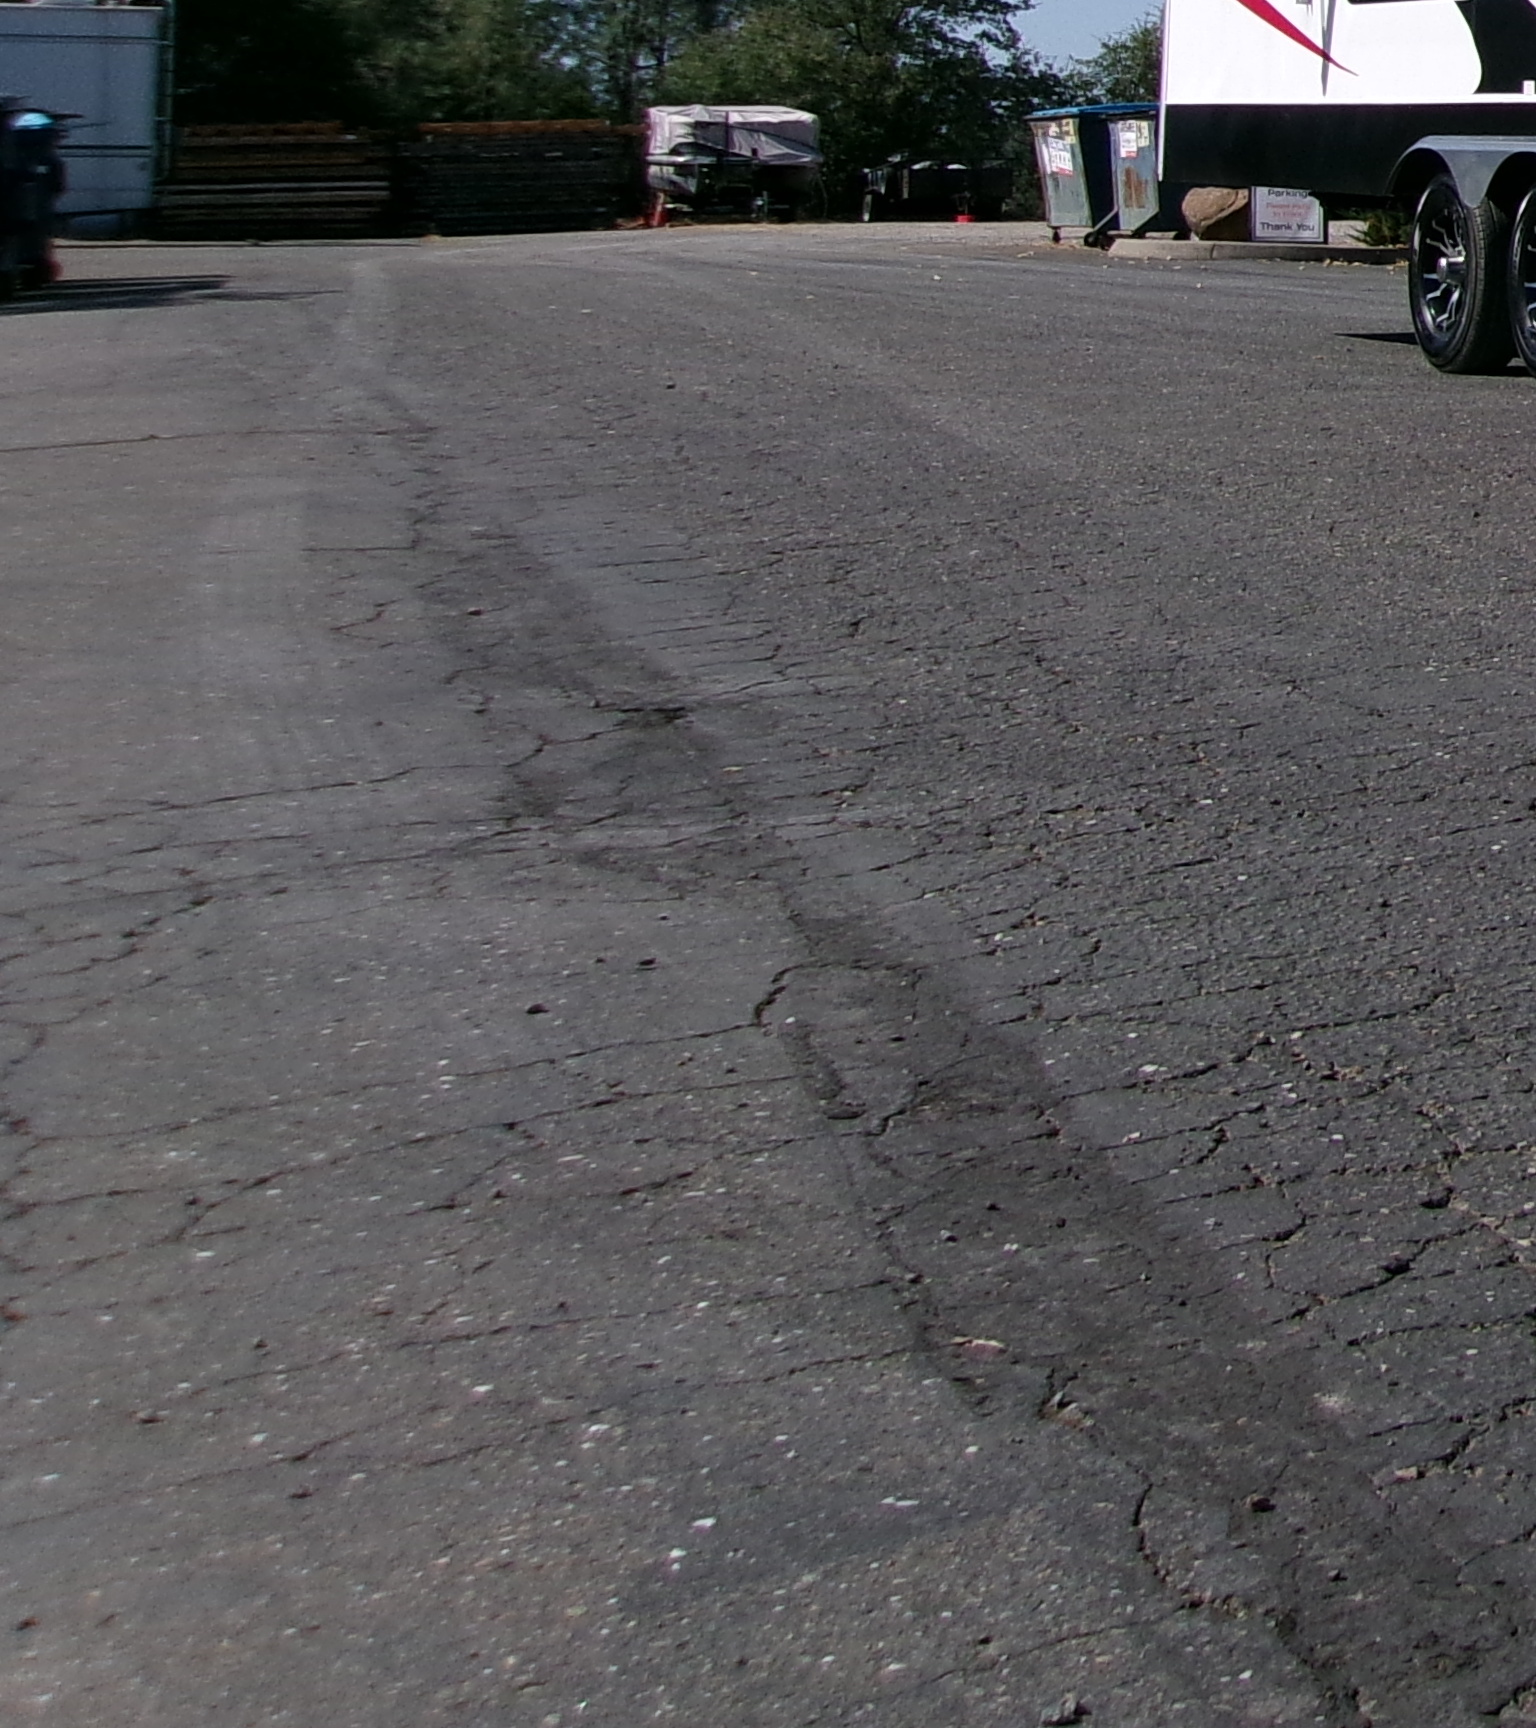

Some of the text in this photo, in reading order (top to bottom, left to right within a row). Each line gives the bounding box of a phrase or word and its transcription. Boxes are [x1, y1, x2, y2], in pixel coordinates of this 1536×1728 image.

[1267, 188, 1308, 199] Parking
[1260, 221, 1315, 233] Thank You
